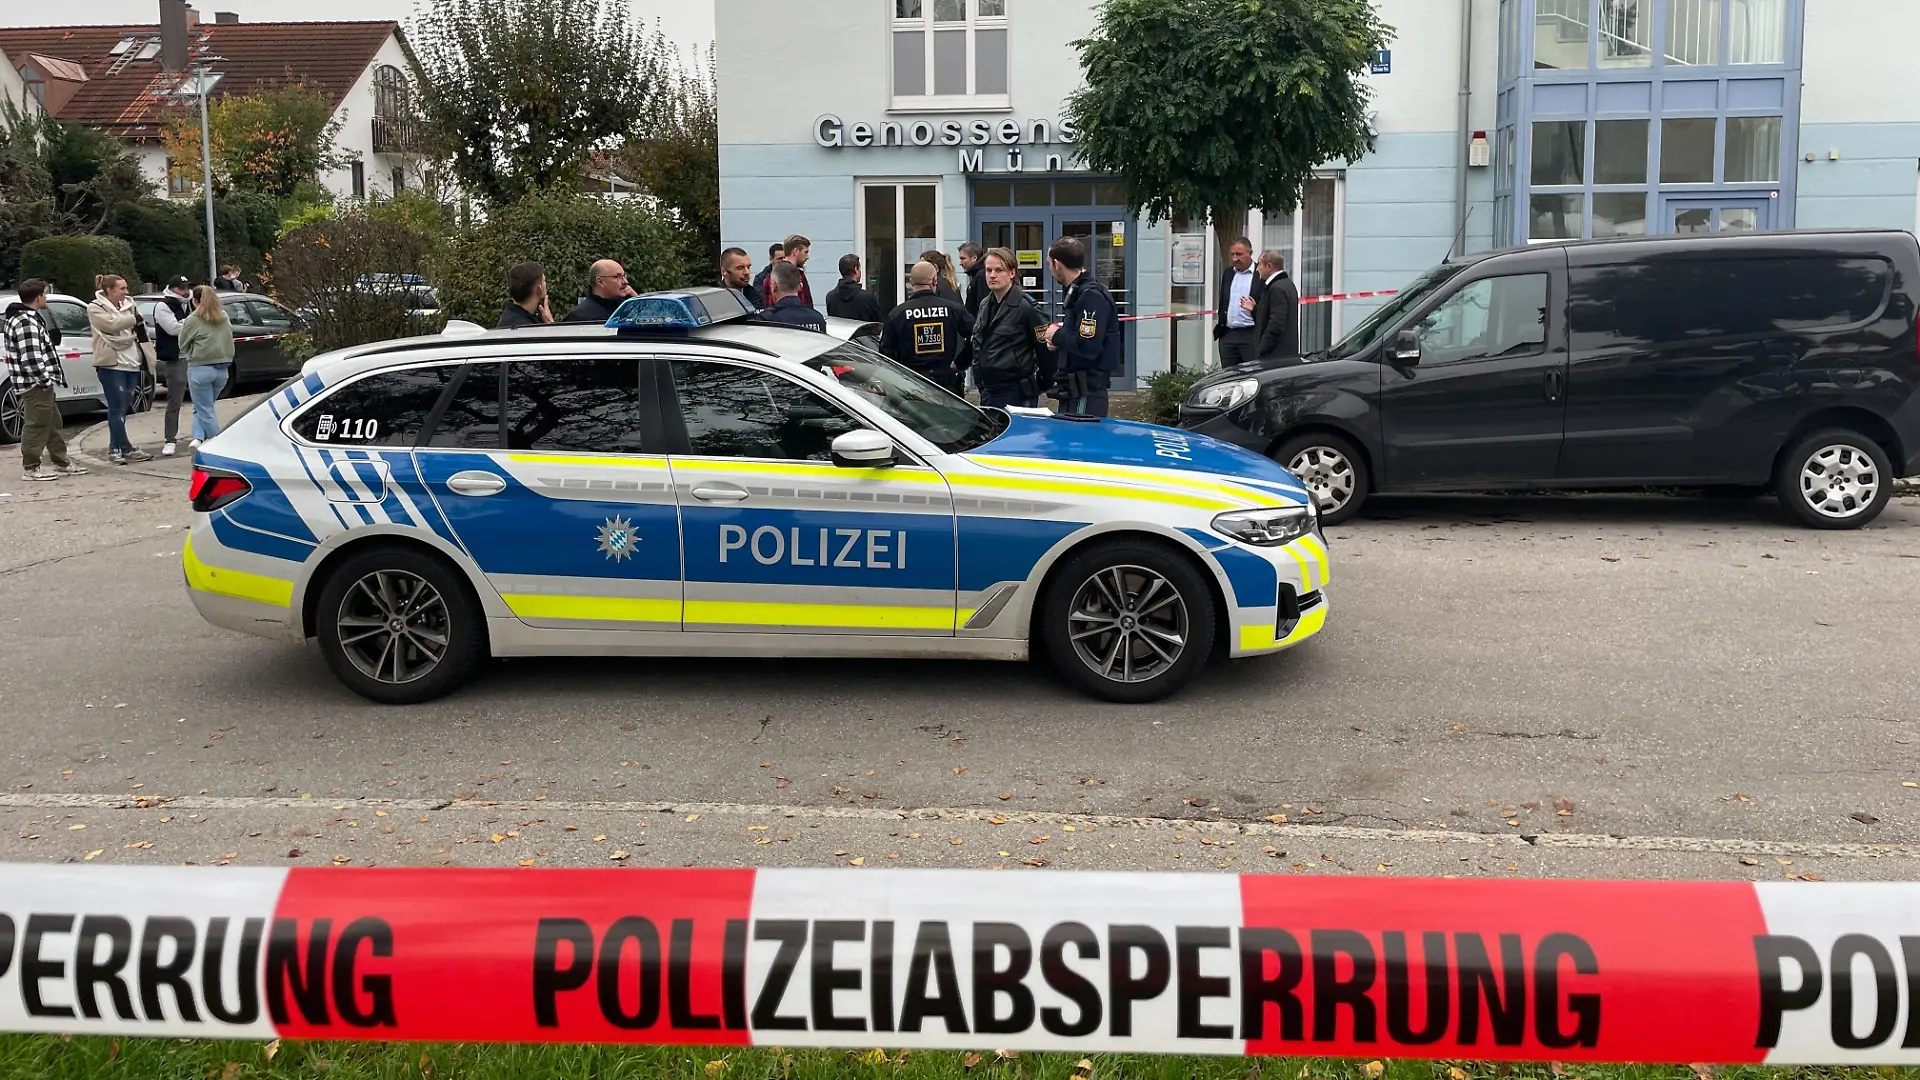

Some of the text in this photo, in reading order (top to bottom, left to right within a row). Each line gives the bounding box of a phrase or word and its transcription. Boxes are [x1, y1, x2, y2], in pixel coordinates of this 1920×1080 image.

[813, 113, 1083, 147] Genossens
[958, 148, 1091, 173] Mün
[905, 307, 948, 319] POLIZEI
[918, 334, 941, 343] M 7330
[923, 326, 934, 335] BY
[339, 418, 378, 439] 110
[719, 524, 906, 569] POLIZEI
[533, 915, 1603, 1049] POLIZEIABSPERRUNG
